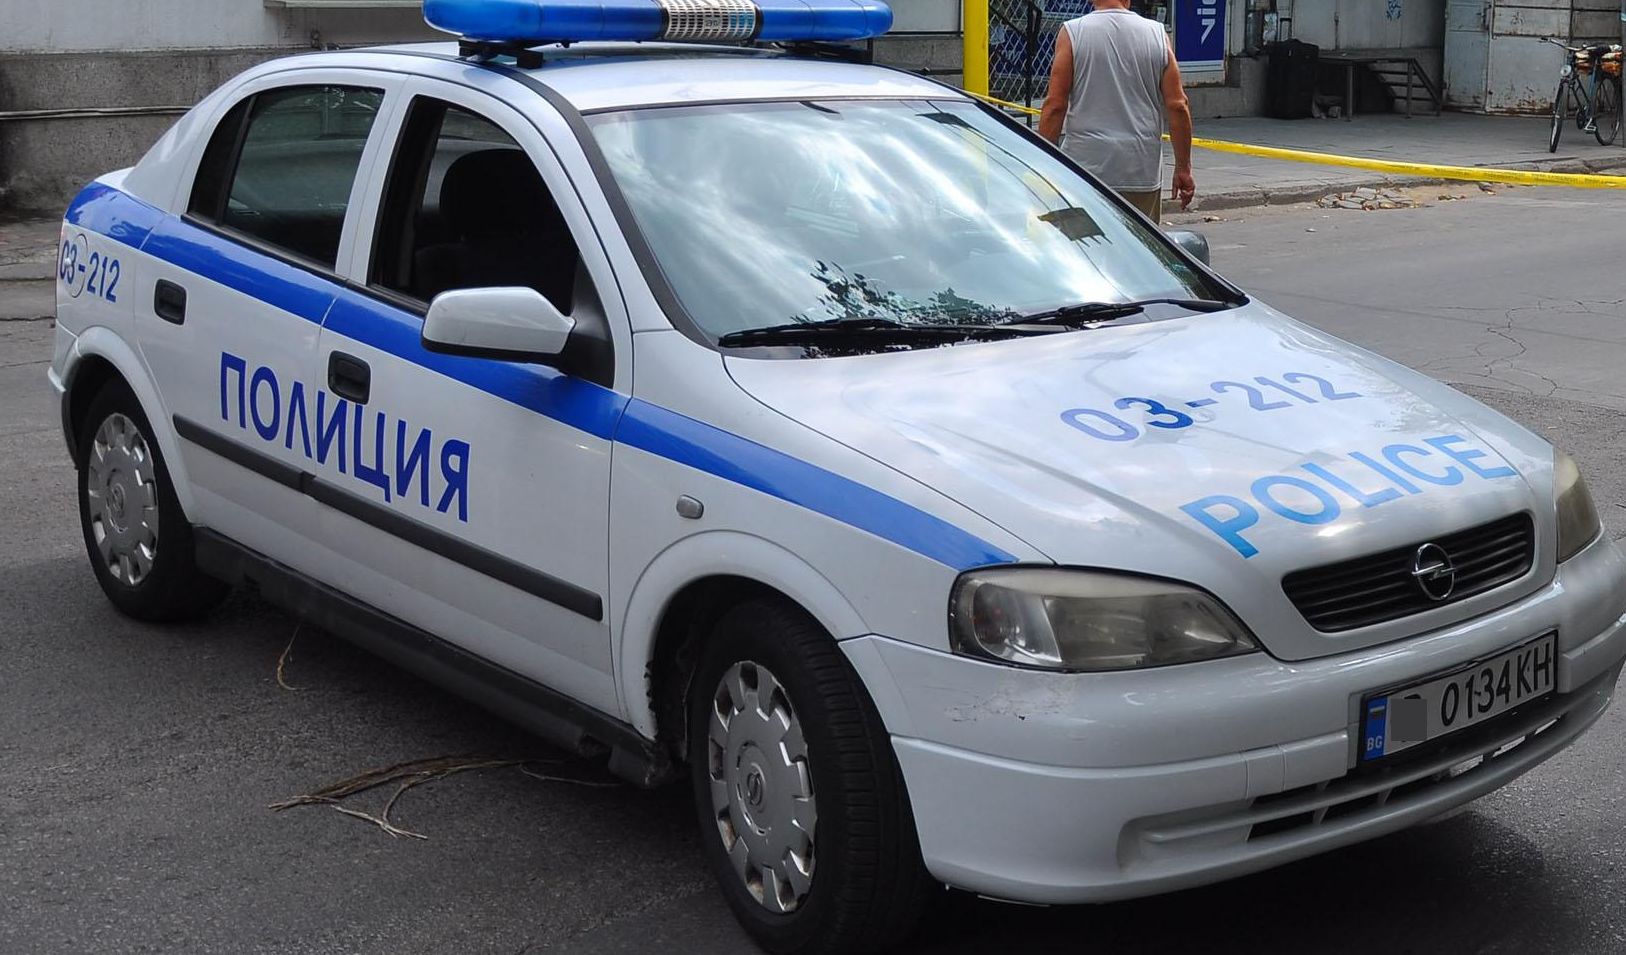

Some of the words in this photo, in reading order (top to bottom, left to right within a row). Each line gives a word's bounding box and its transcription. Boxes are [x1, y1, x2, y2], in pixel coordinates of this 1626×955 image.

[220, 351, 471, 523] ПОЛИЦИЯ
[1060, 372, 1363, 442] 03-212
[1179, 434, 1520, 560] POLICE
[1366, 735, 1383, 751] BG
